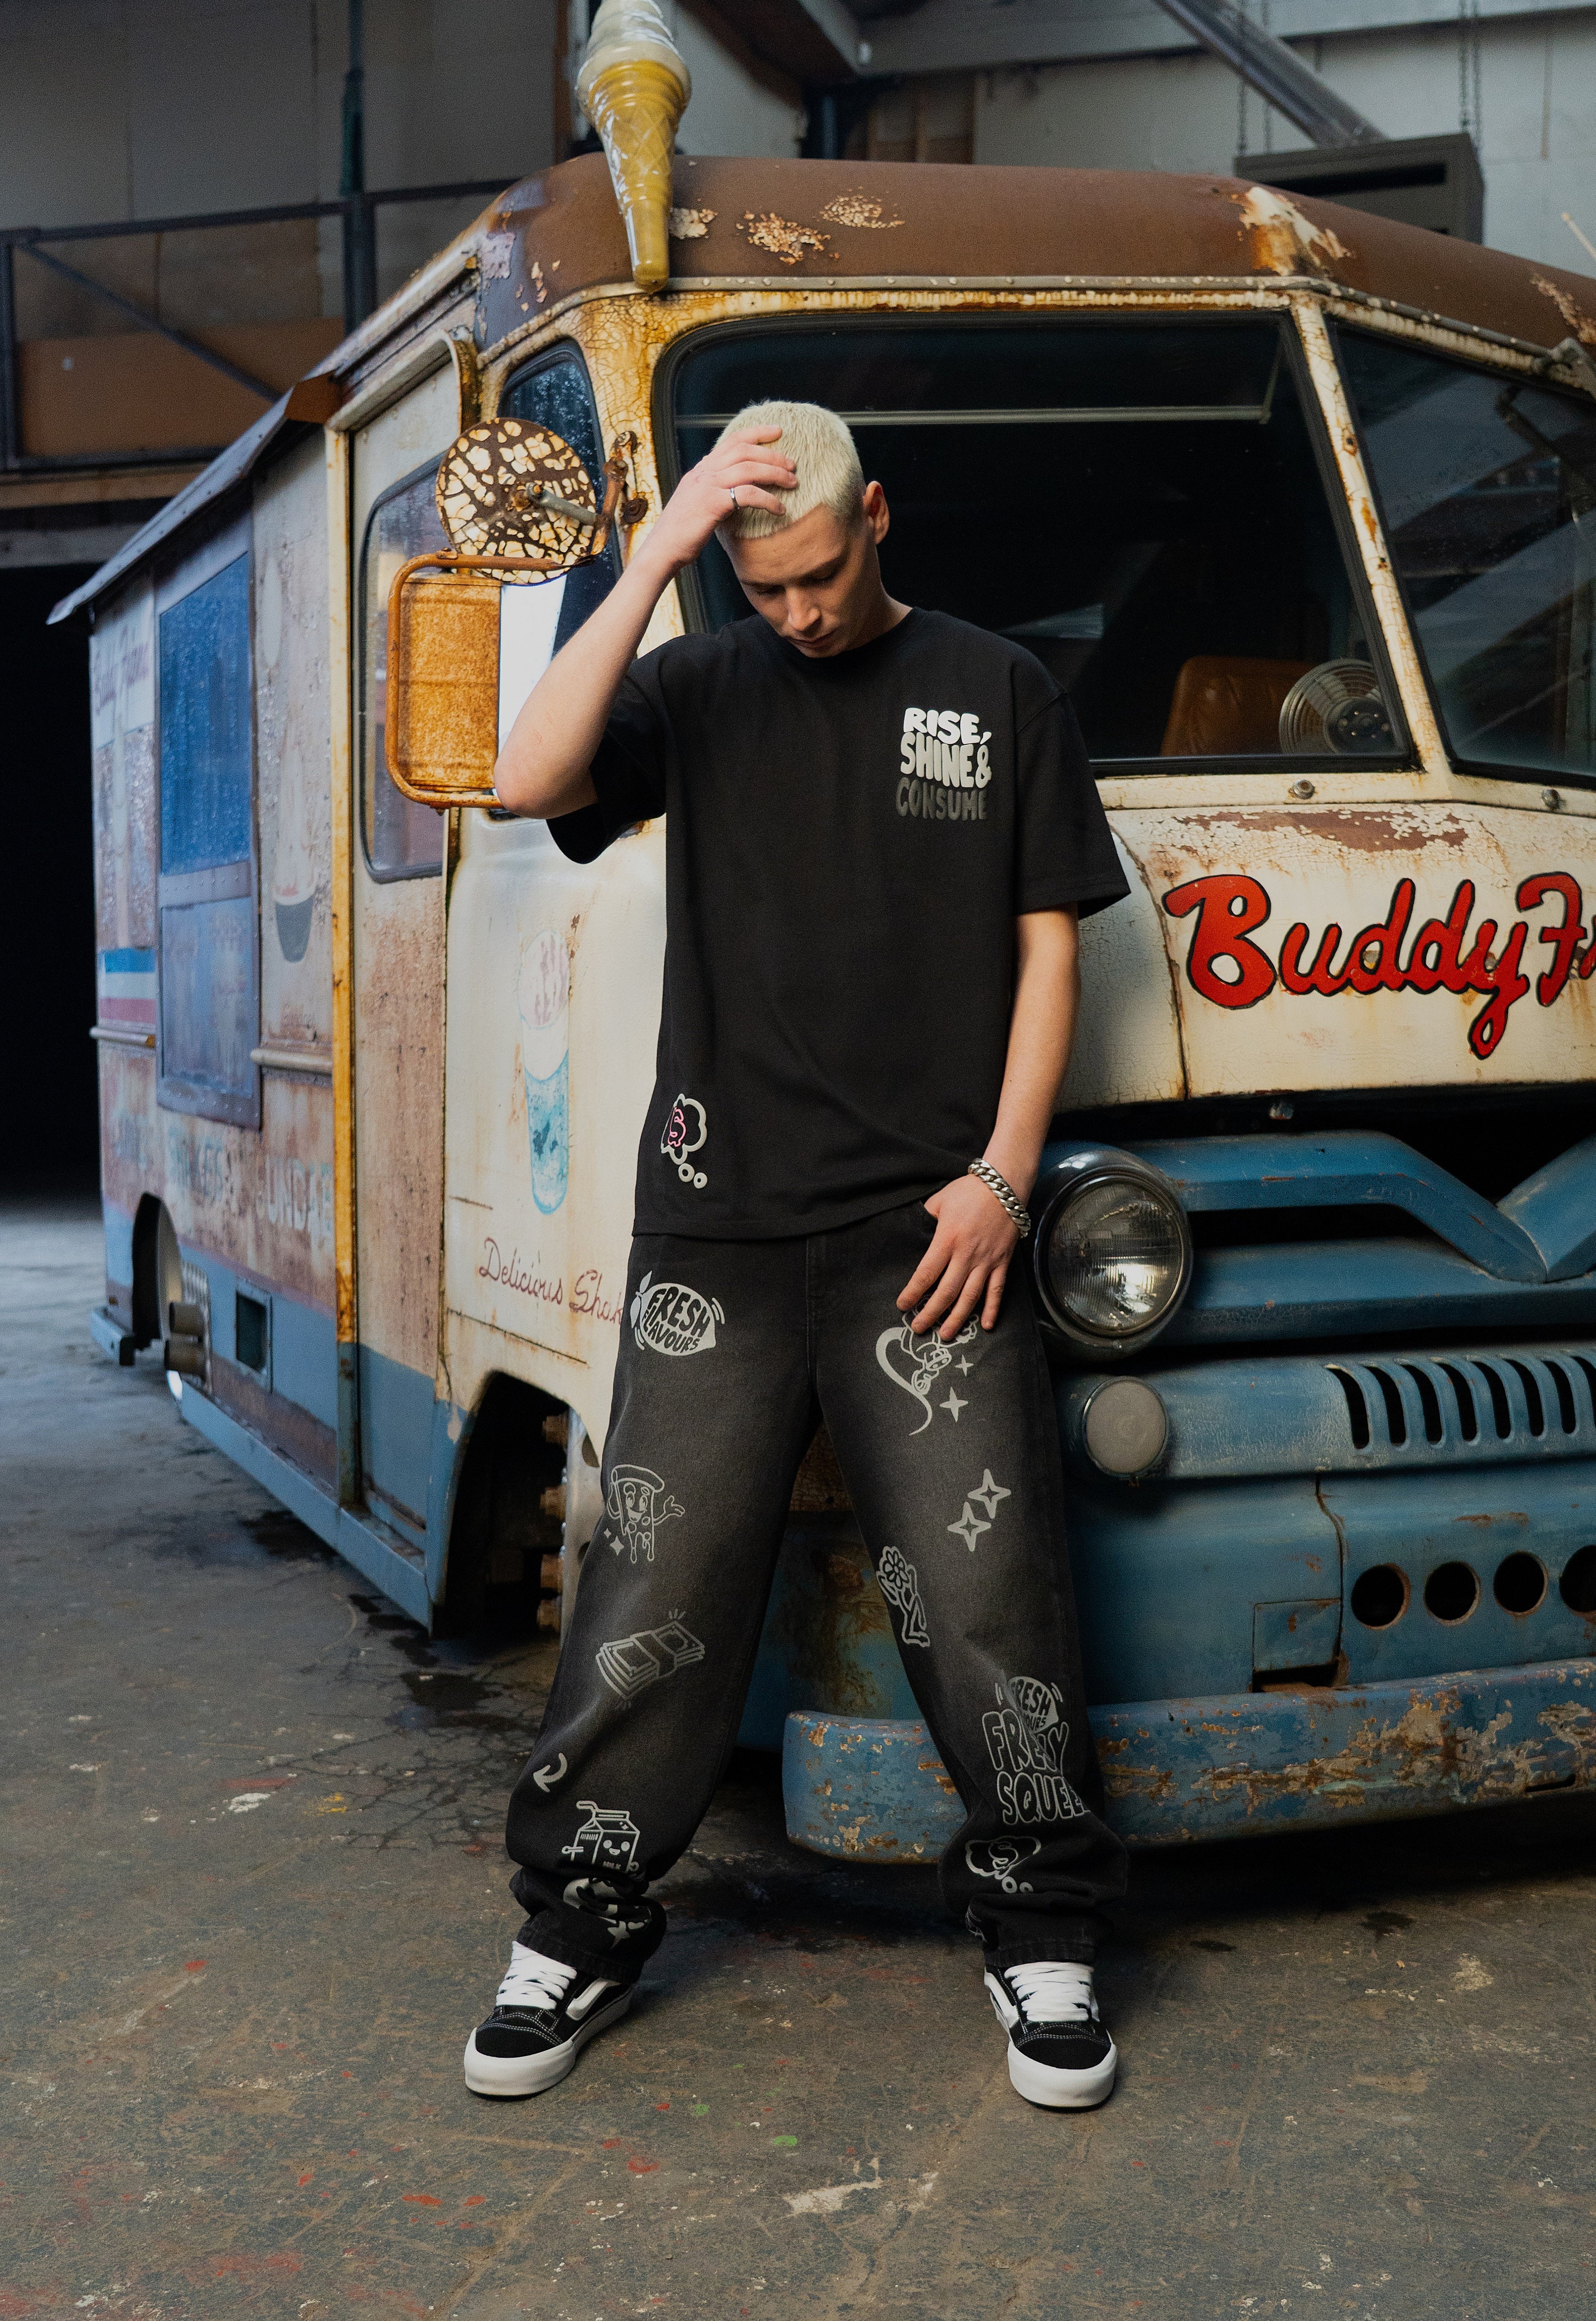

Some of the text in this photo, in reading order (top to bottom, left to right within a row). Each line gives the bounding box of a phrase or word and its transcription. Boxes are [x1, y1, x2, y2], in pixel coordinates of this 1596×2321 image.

[904, 707, 992, 745] RISE,
[1162, 871, 1596, 1060] Buddy F
[478, 1236, 624, 1325] Delicious Shak
[641, 1309, 701, 1353] FLAVOURS
[647, 1286, 711, 1338] FRESH
[997, 1771, 1091, 1825] SQUEE
